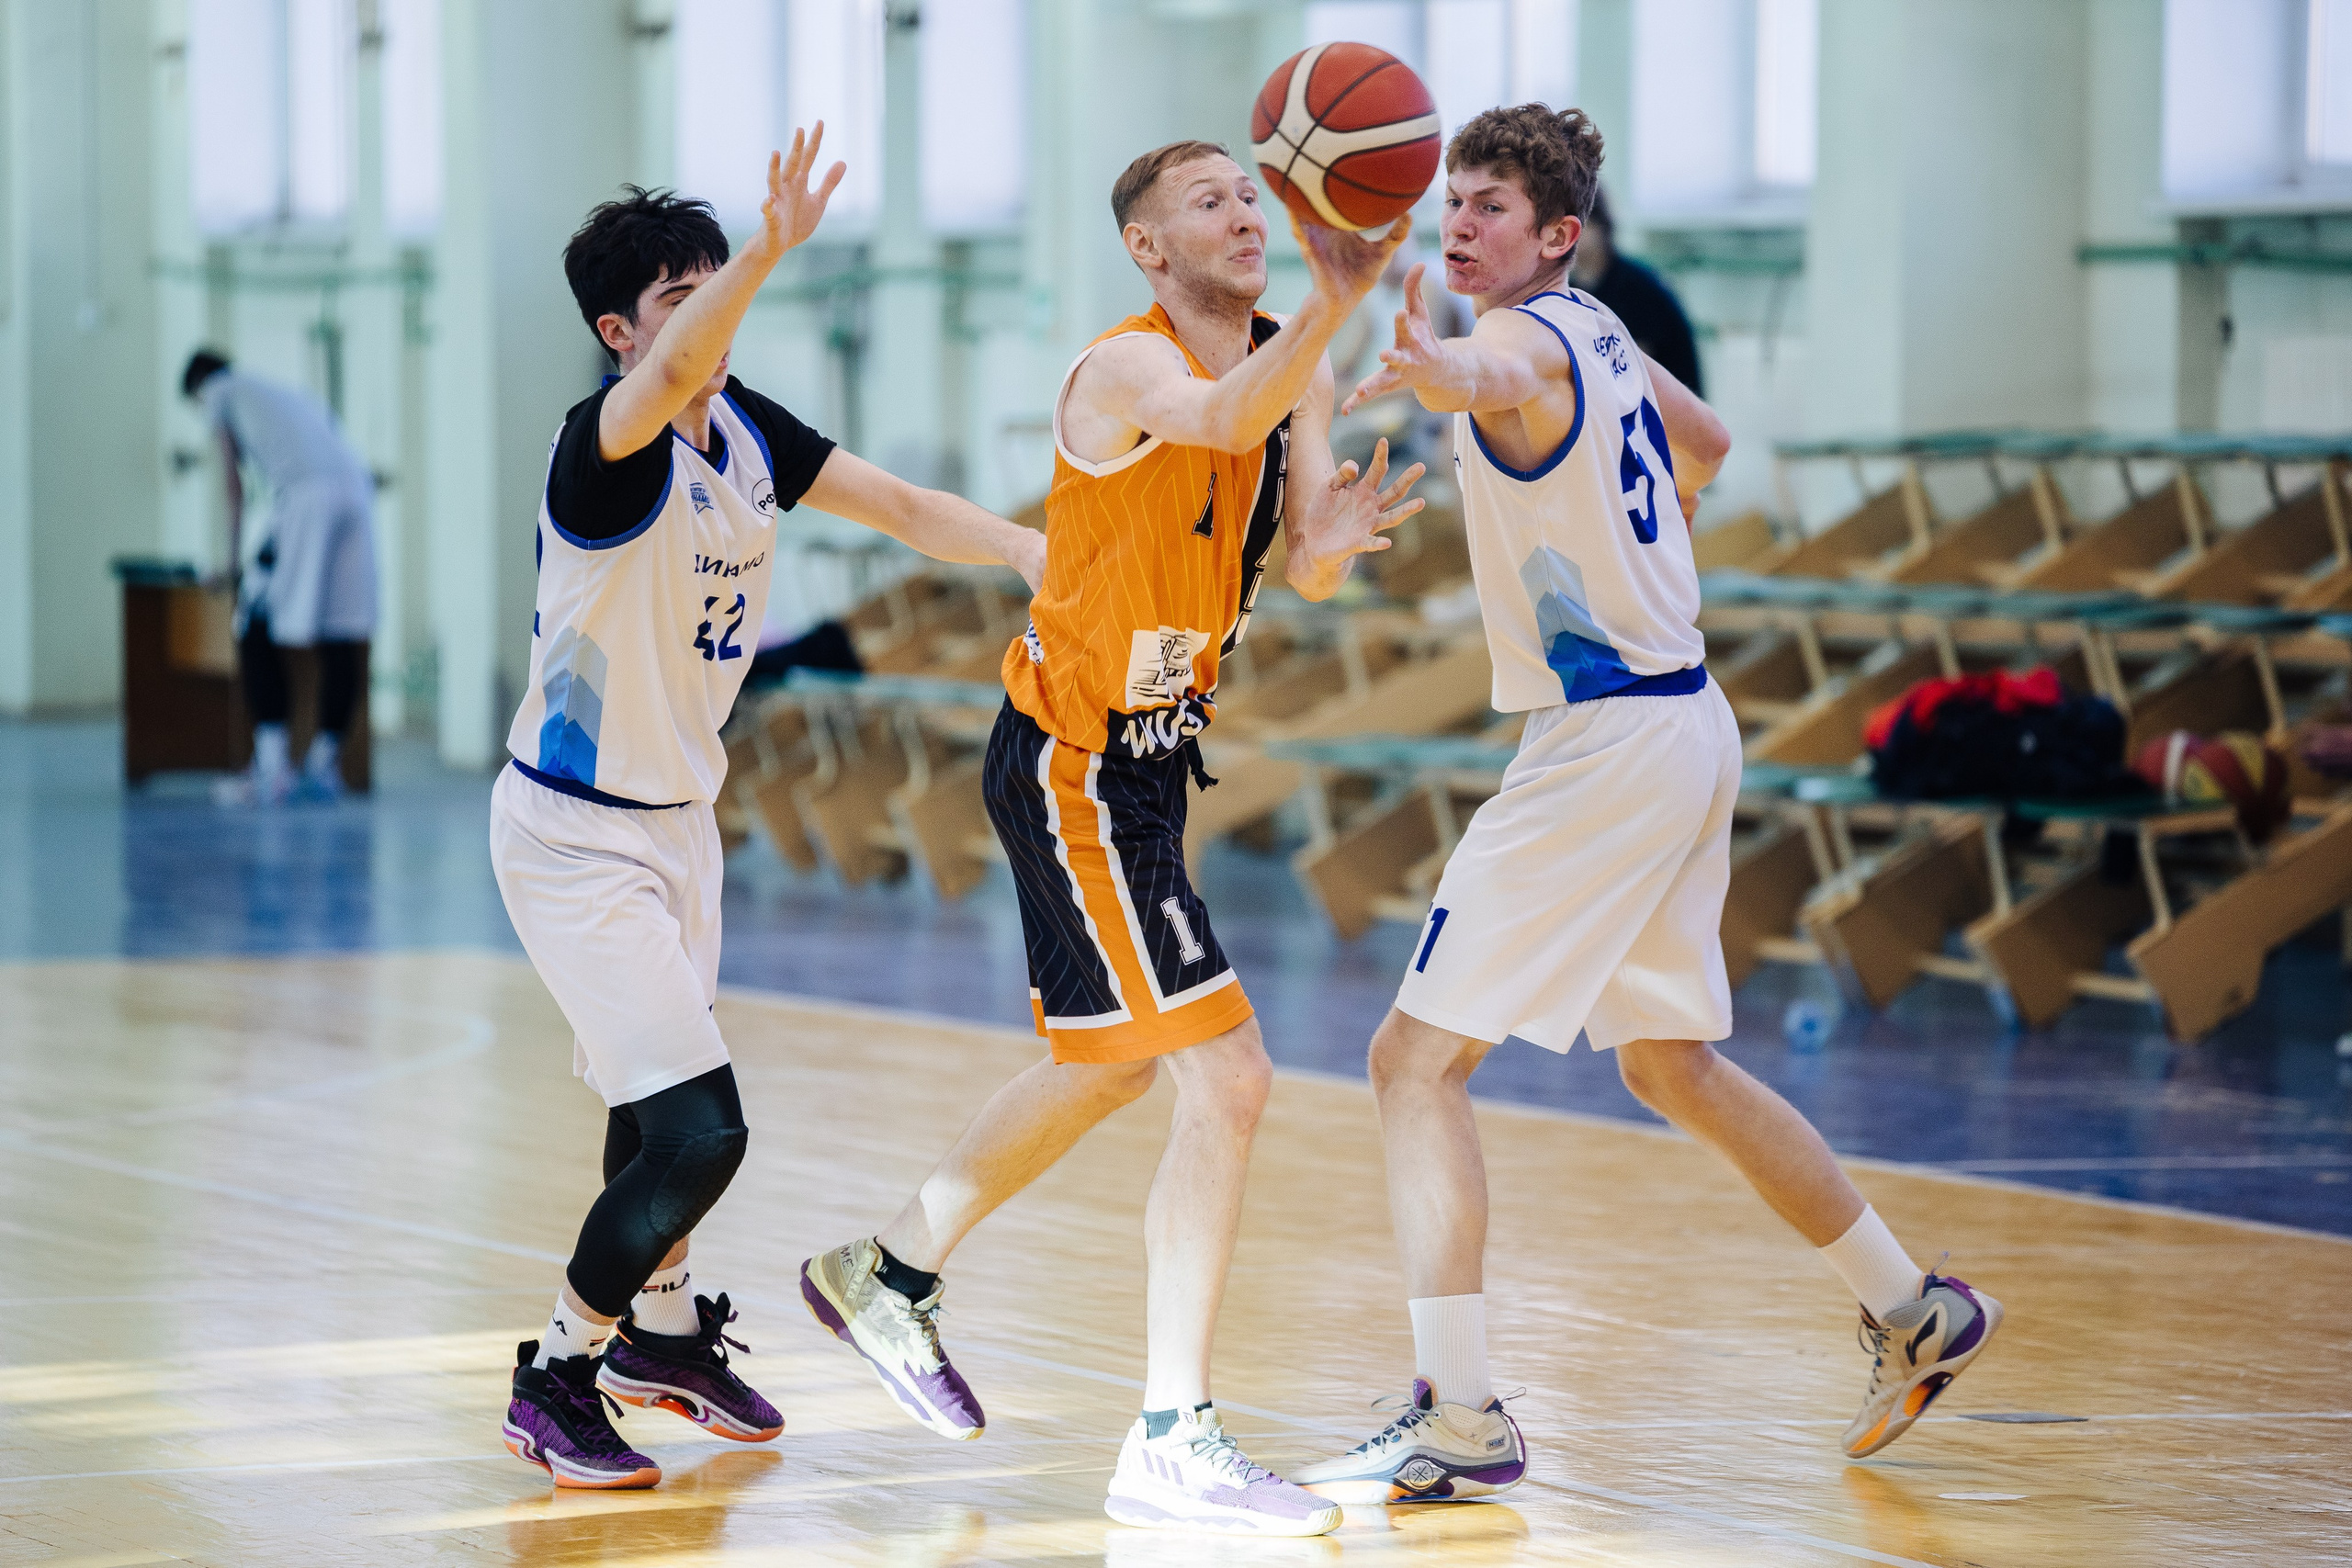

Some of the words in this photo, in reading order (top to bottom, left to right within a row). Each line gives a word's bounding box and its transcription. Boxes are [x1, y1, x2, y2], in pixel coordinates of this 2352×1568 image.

[758, 491, 775, 511] РФ
[695, 551, 765, 578] ИНАМО
[1160, 897, 1205, 965] 1
